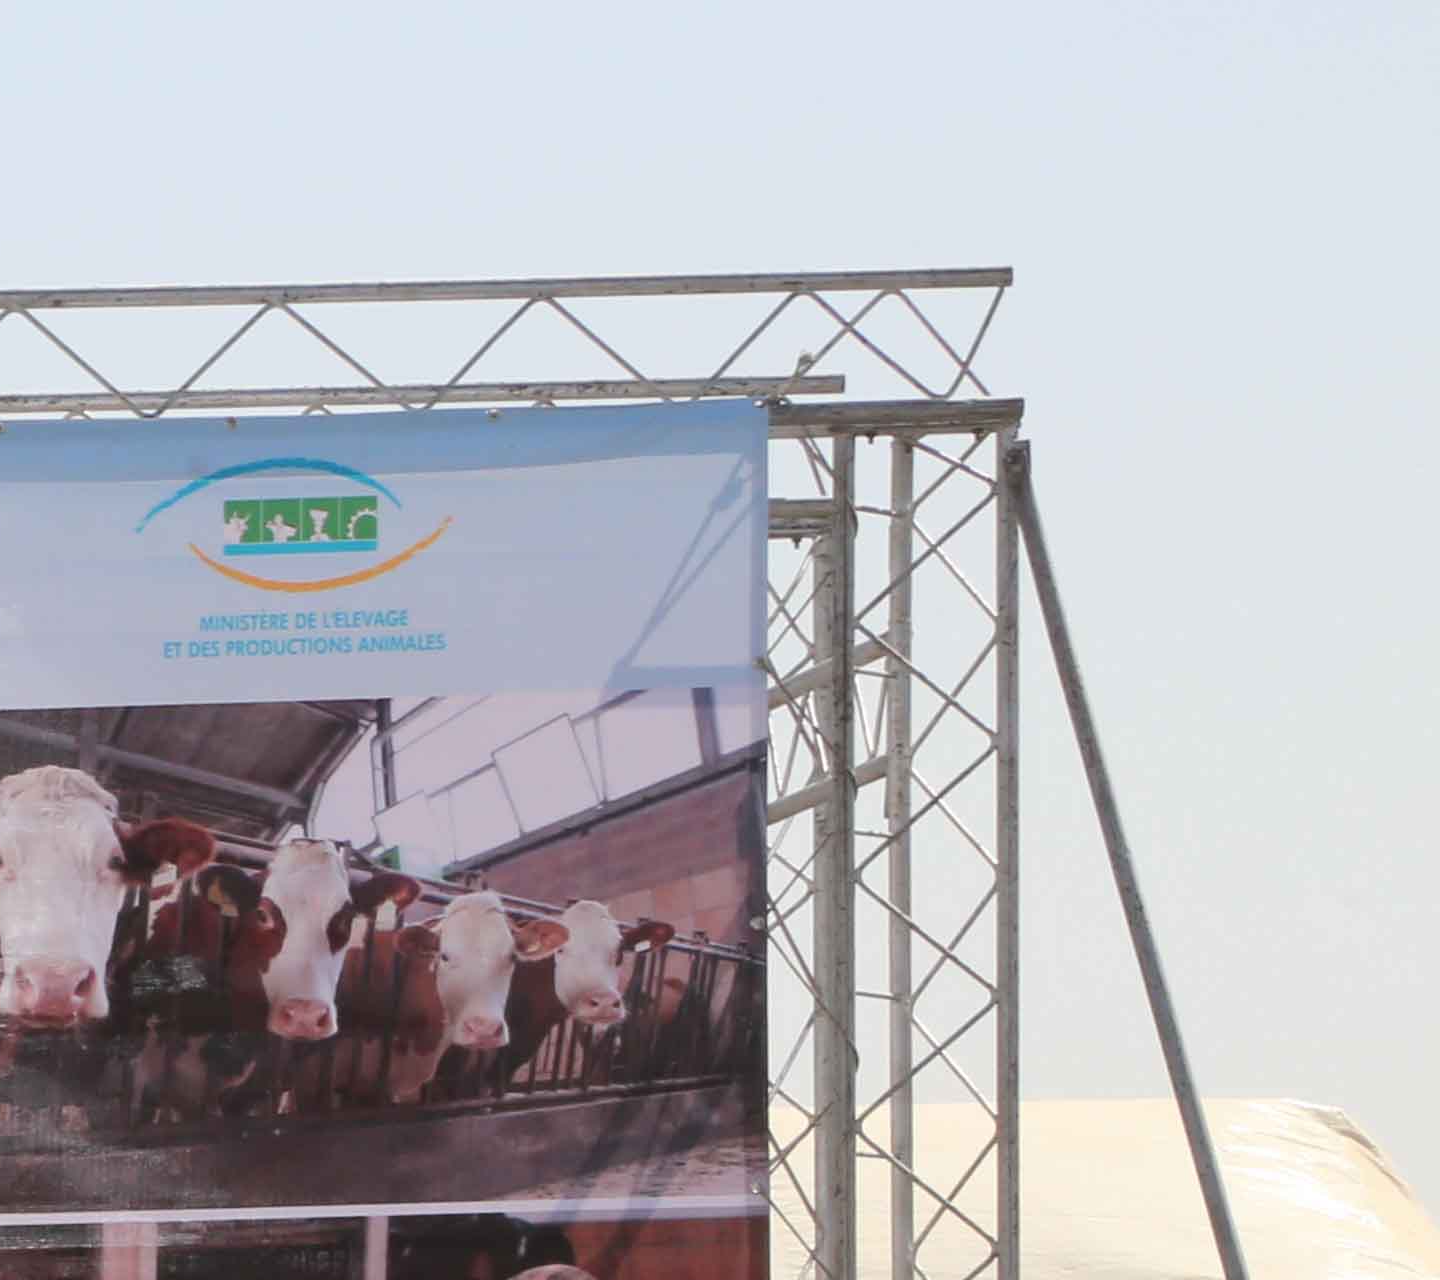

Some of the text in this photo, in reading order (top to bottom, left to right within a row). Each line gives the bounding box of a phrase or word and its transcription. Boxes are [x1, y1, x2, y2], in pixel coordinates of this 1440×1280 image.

[199, 609, 289, 633] MINISTÈRE
[294, 612, 317, 630] DE
[163, 633, 448, 659] ET DES PRODUCTIONS ANIMALES
